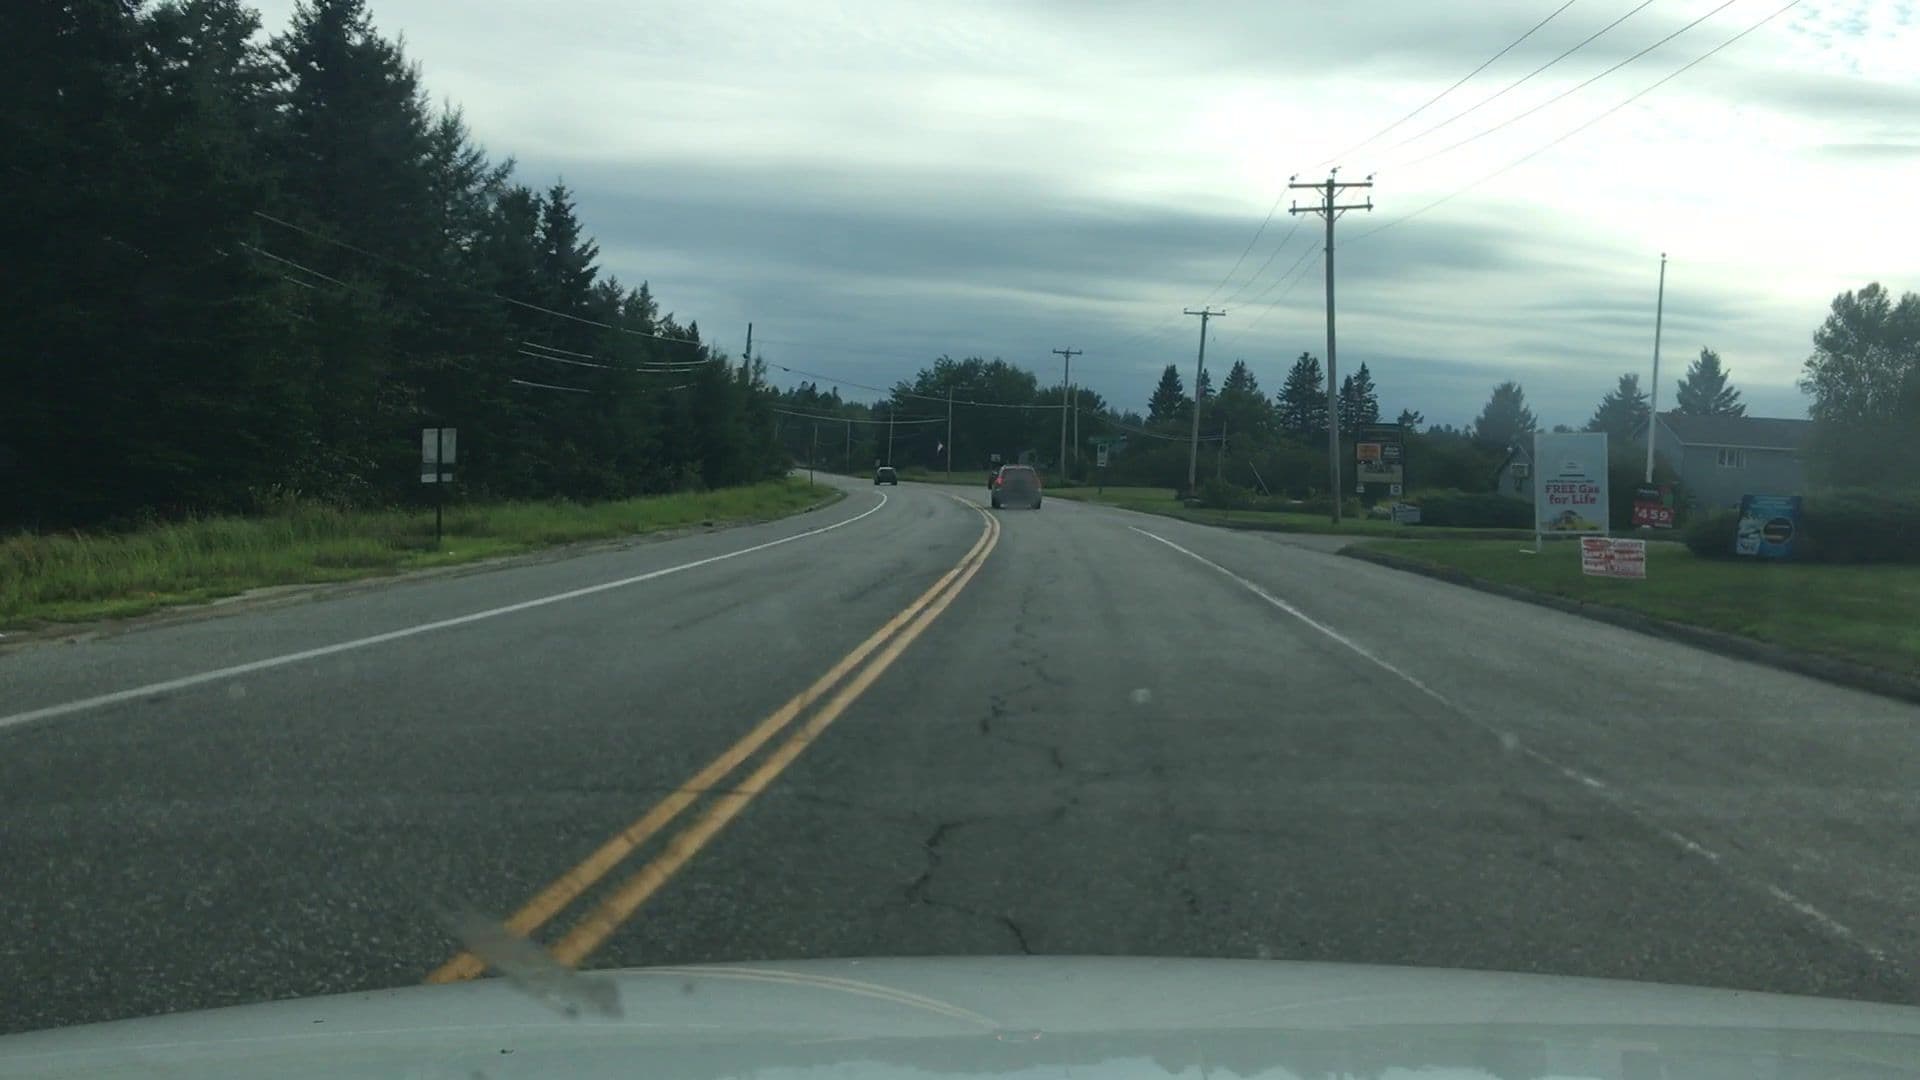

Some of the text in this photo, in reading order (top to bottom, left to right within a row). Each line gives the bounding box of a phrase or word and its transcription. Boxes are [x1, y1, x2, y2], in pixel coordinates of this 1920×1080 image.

[1545, 484, 1600, 494] FREE Gas
[1549, 493, 1597, 504] for Life
